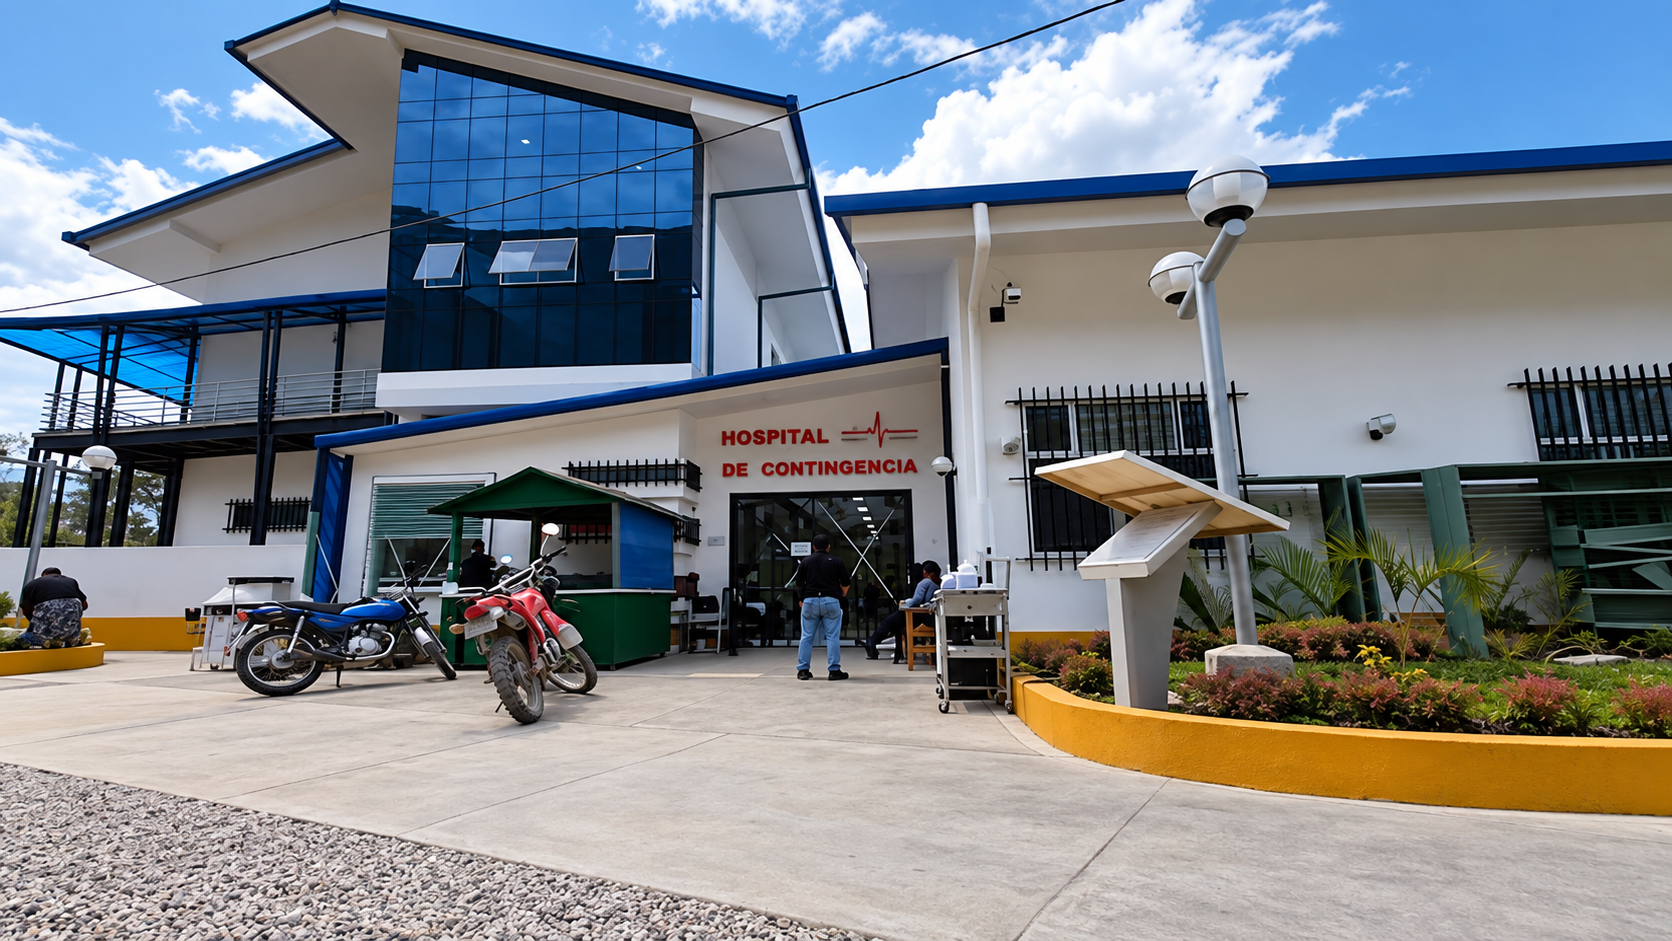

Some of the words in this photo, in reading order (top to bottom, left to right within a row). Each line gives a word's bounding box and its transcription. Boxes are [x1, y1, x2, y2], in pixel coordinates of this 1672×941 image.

[721, 428, 830, 446] HOSPITAL
[722, 462, 749, 477] DE
[761, 458, 918, 477] CONTINGENCIA
